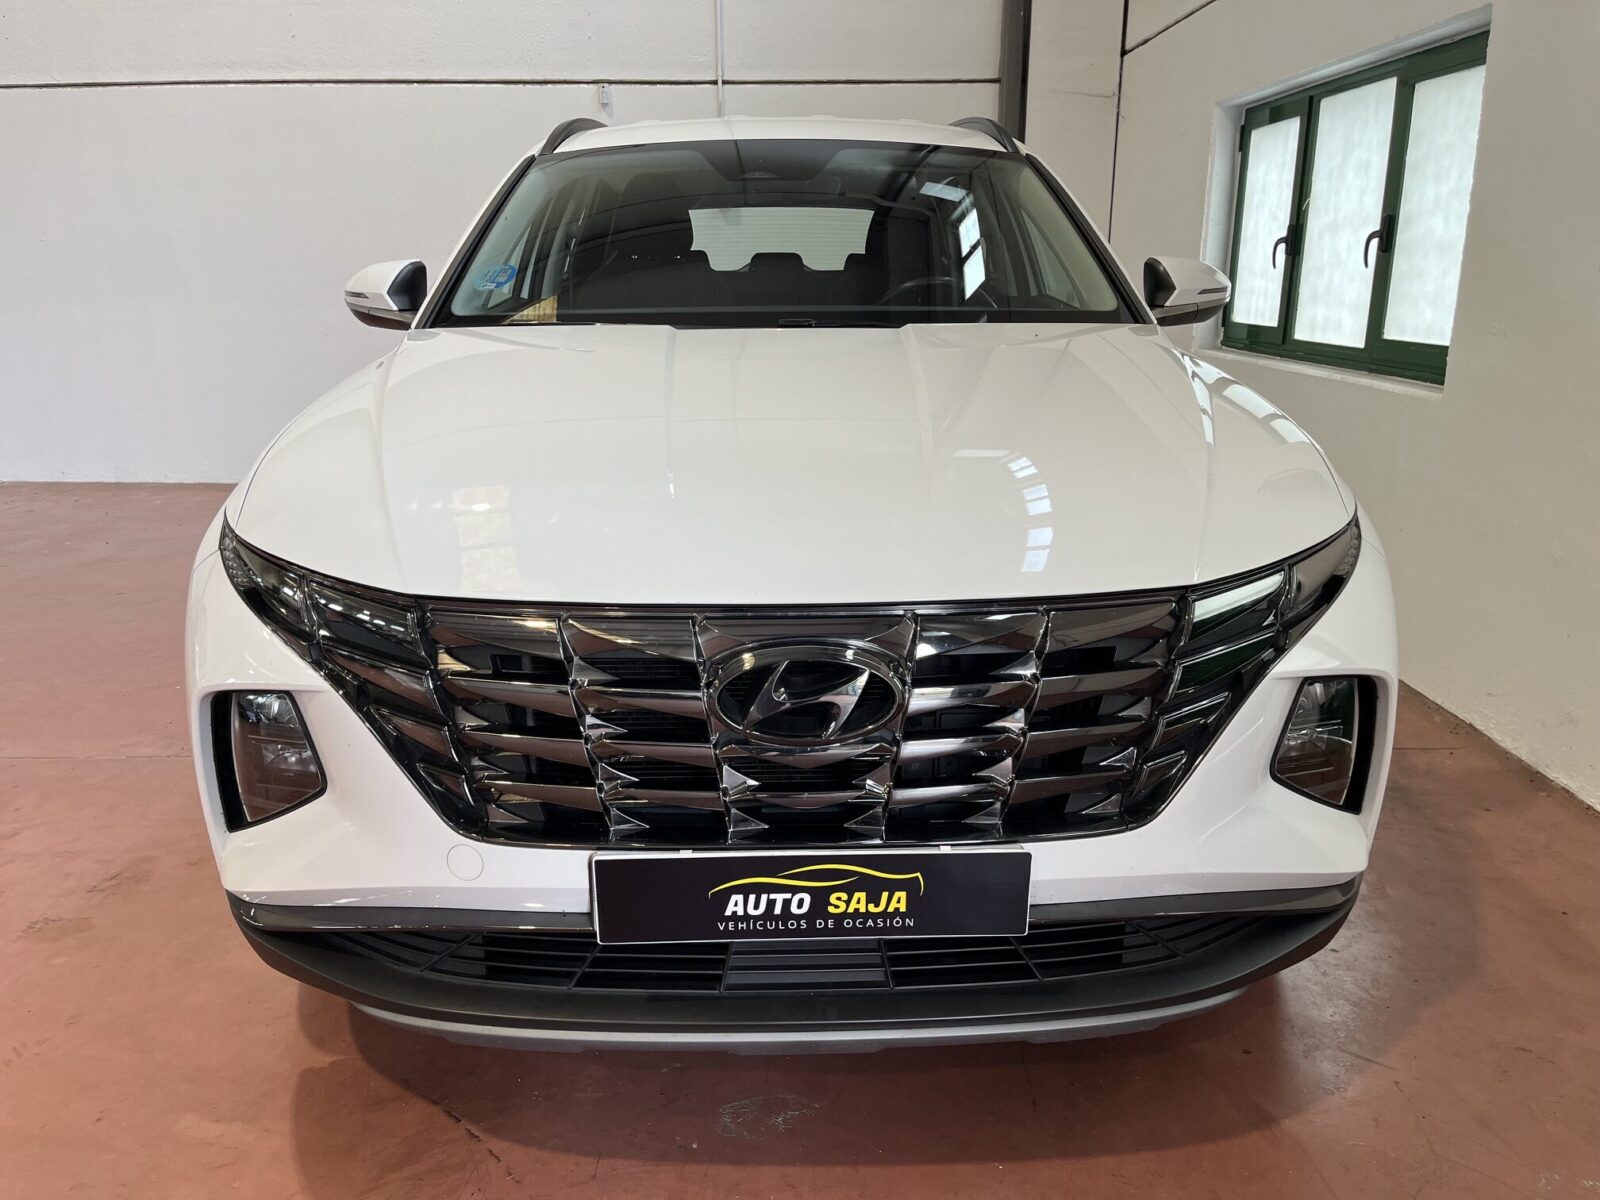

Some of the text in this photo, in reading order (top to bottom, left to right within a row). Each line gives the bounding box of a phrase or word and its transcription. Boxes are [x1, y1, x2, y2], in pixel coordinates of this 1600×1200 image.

[724, 891, 907, 916] AUTO SAJA
[717, 916, 915, 931] VEHÍCULOS DE OCASIÓN
